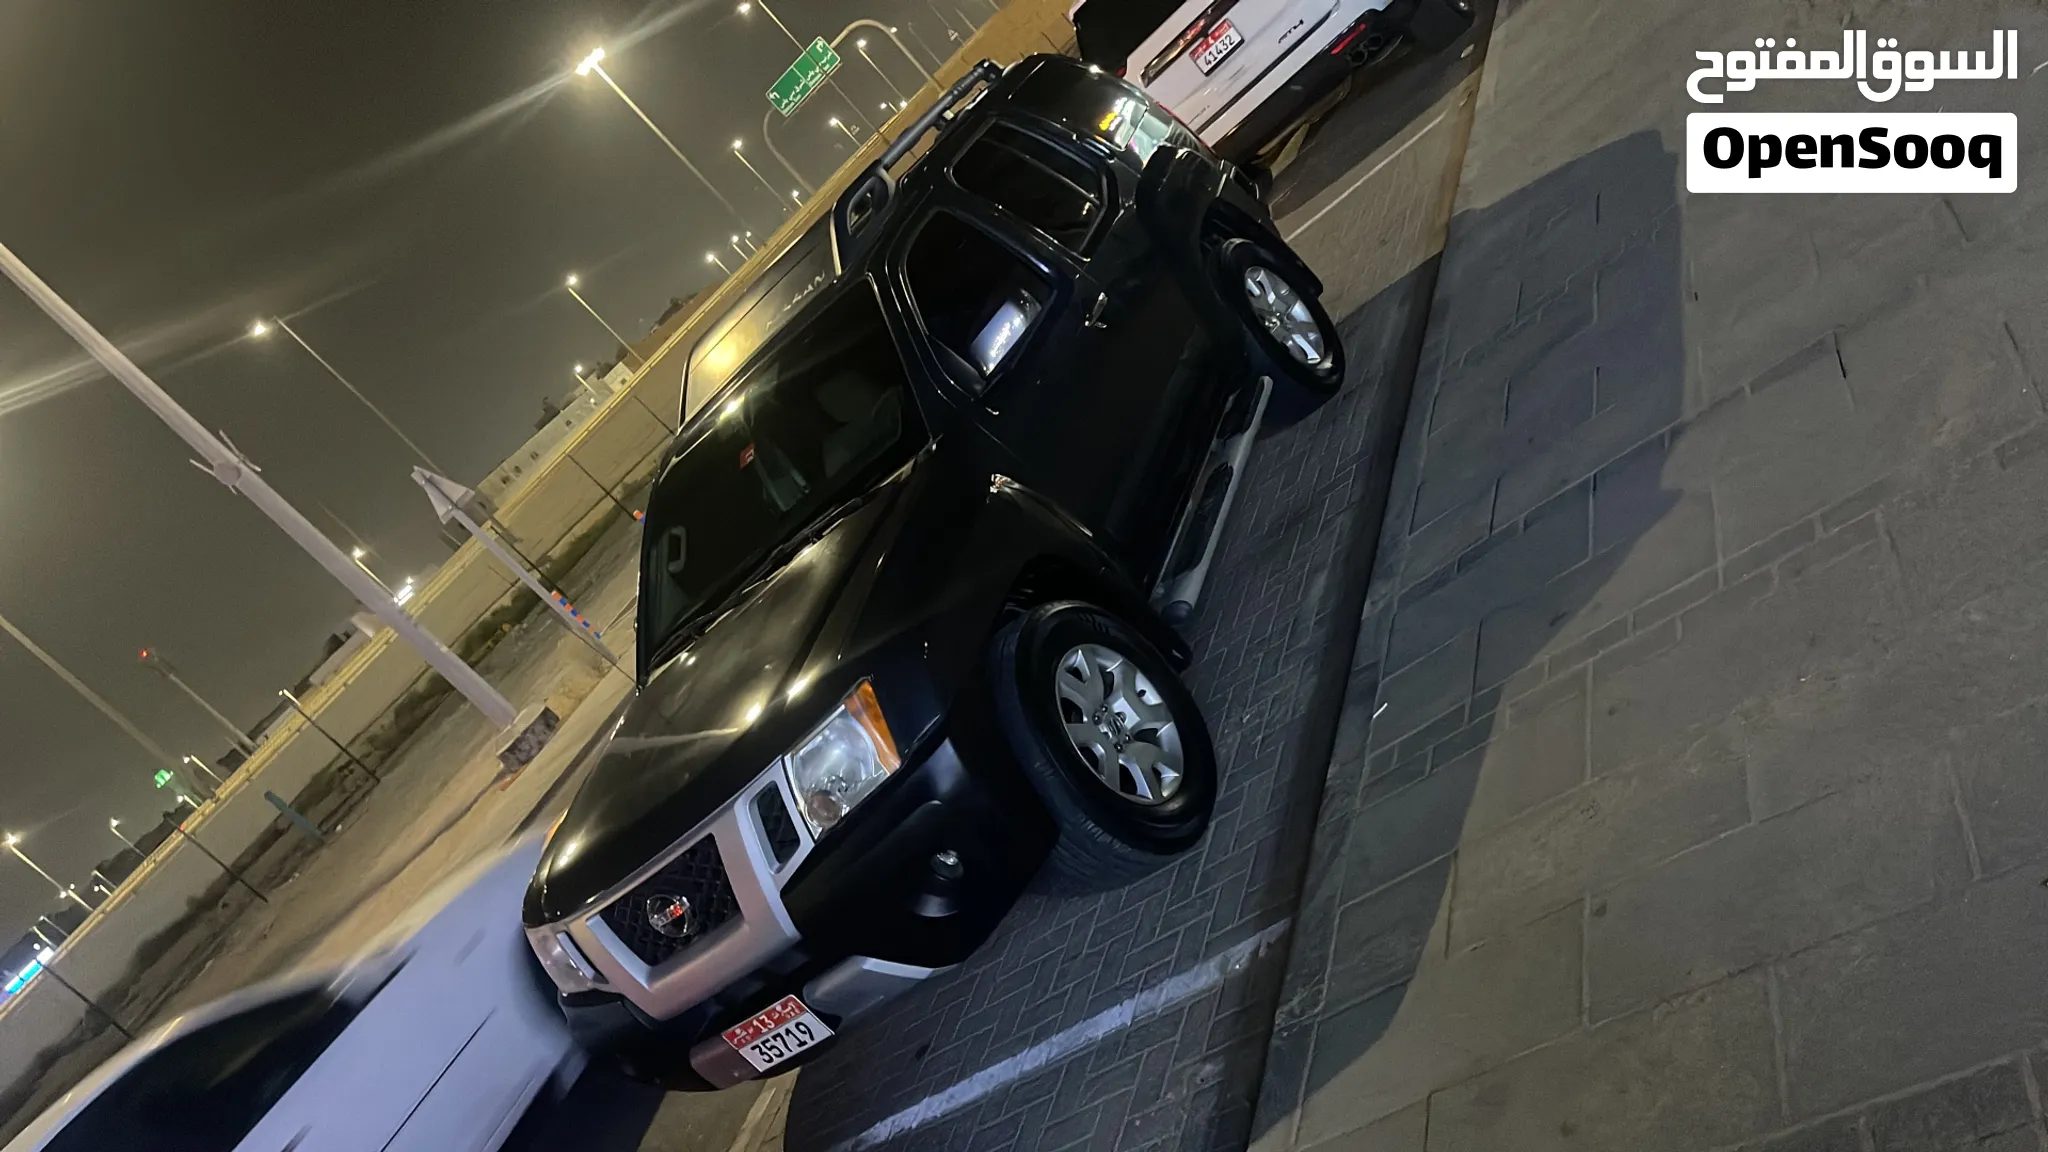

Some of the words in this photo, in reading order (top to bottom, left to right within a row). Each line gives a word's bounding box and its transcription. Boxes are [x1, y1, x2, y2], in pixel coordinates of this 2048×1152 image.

[1204, 35, 1235, 66] 41432
[753, 1014, 776, 1034] 13
[750, 1021, 815, 1064] 35719
